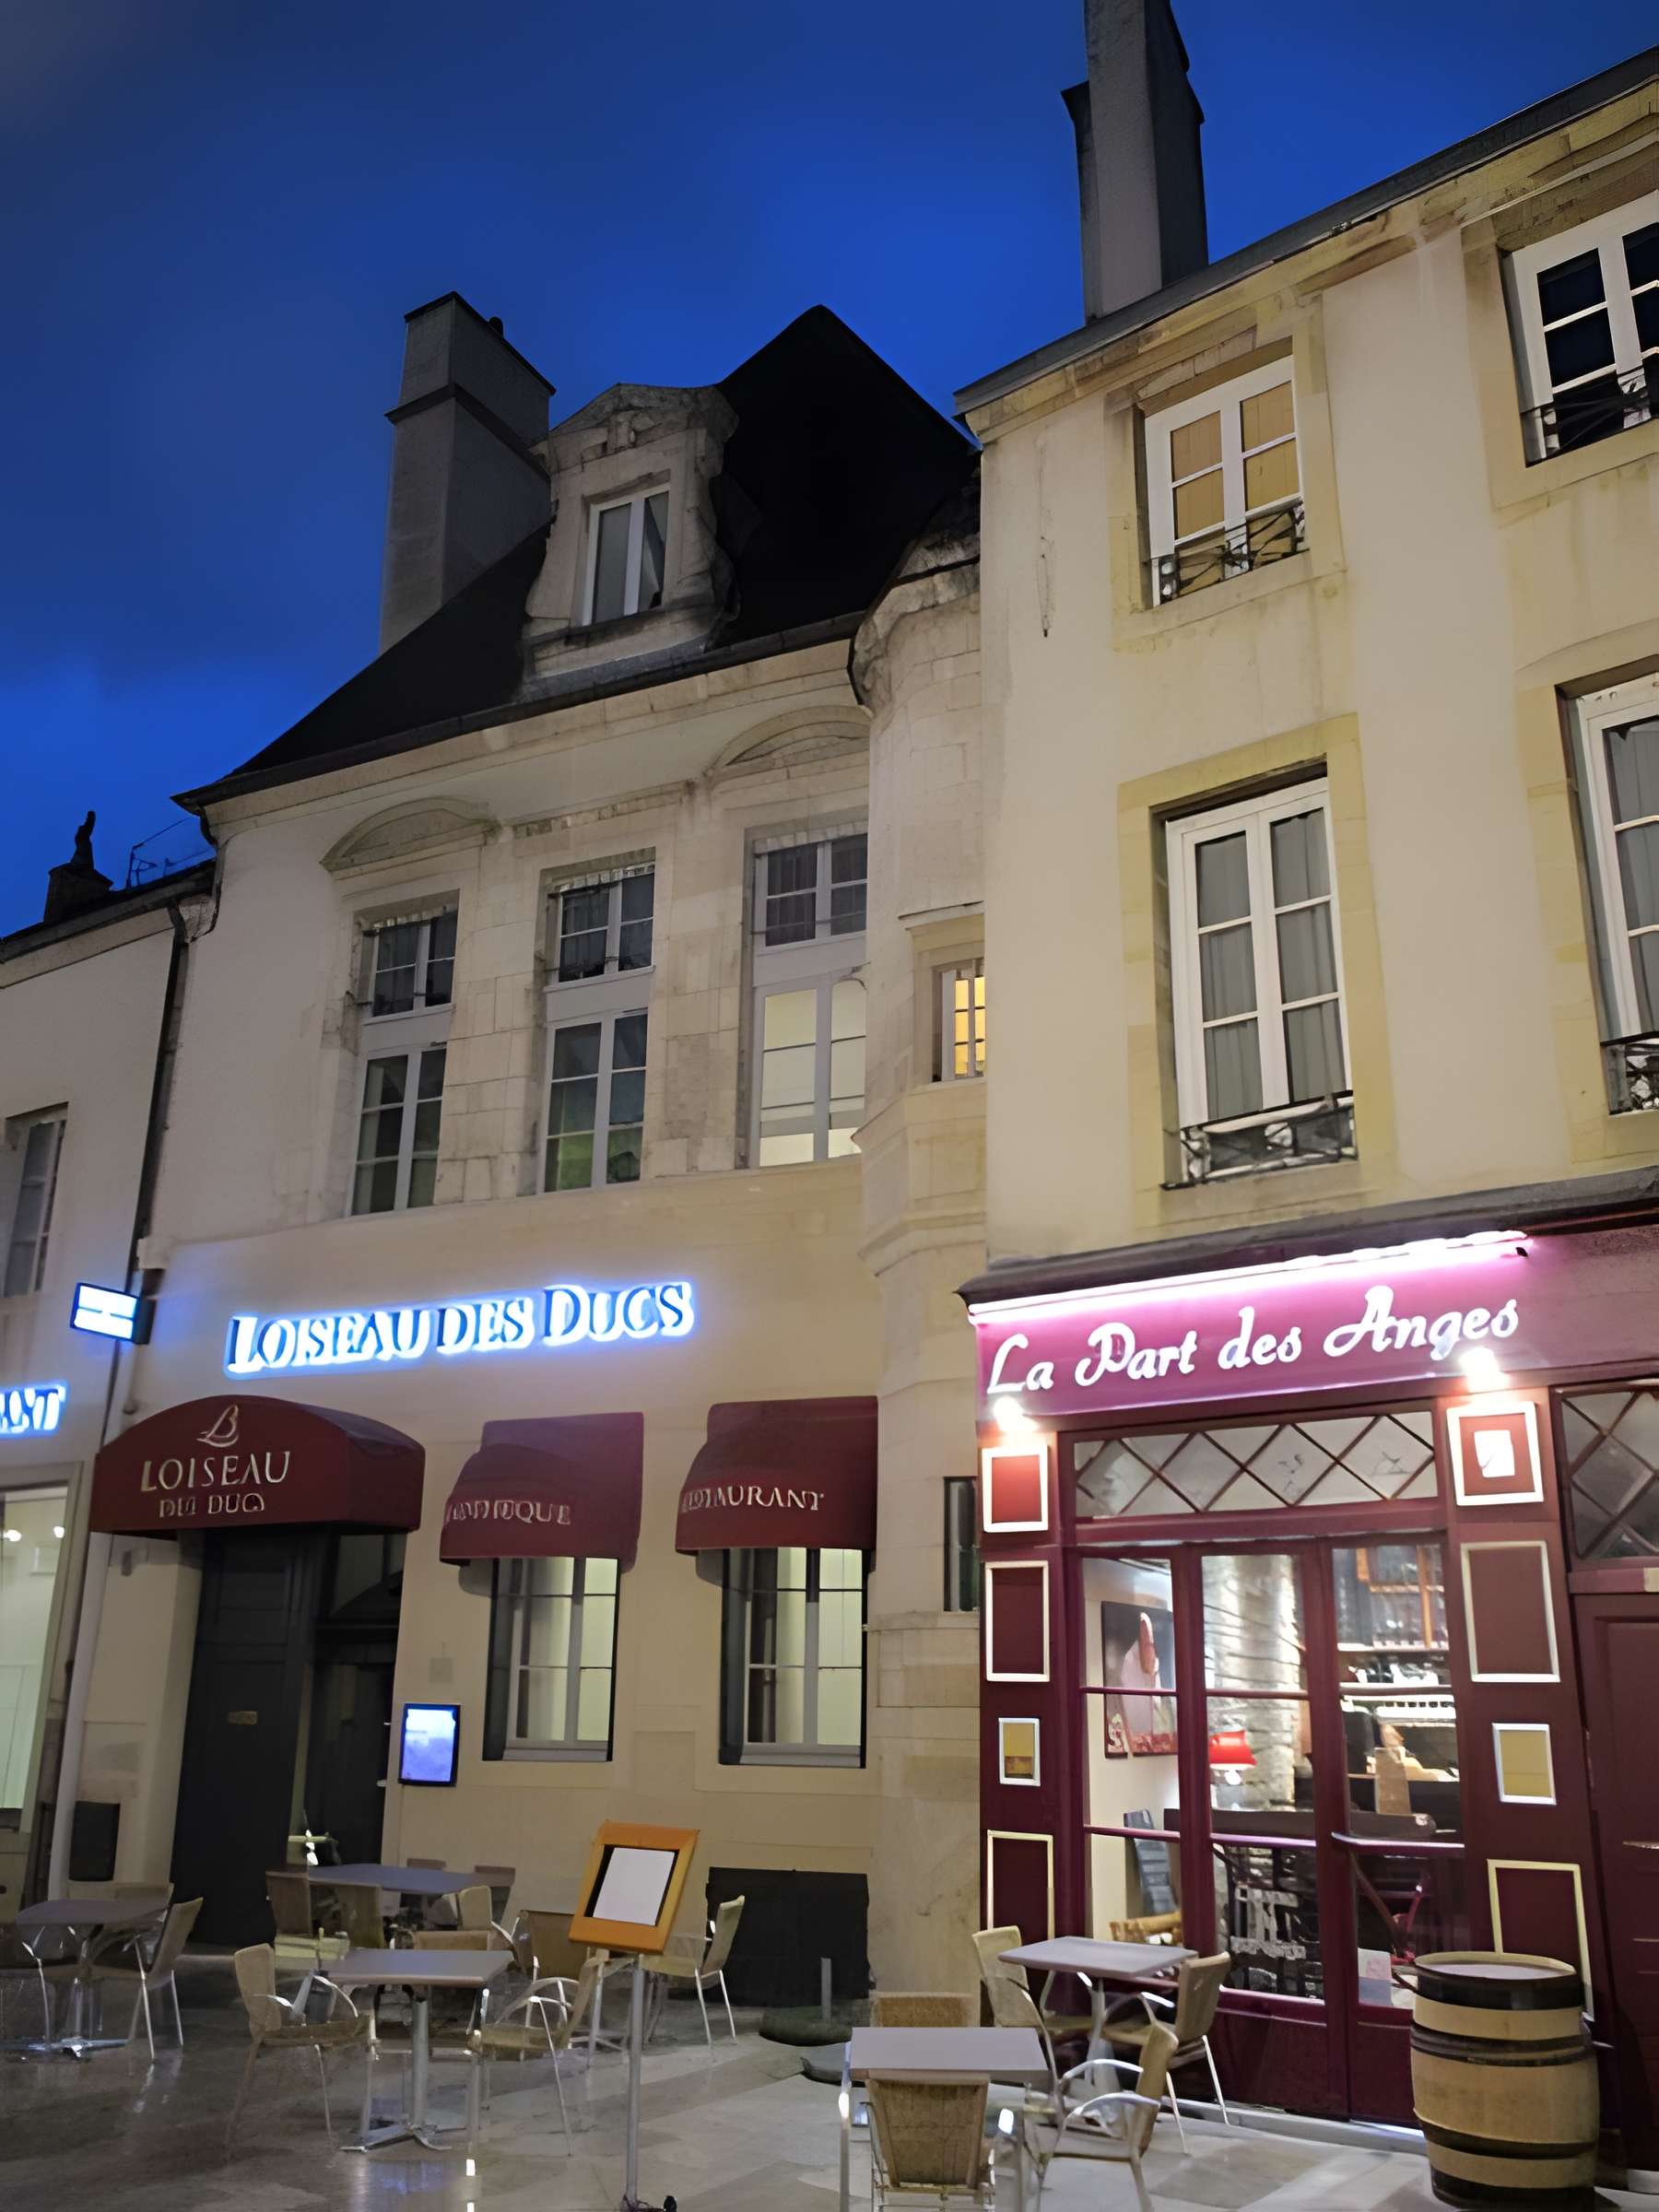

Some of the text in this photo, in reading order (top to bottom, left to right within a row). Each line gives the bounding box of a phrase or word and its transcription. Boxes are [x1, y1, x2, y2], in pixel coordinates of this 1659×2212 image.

[437, 1298, 534, 1353] DES
[542, 1282, 695, 1347] DUCS
[986, 1284, 1520, 1394] La Part des Anges
[140, 1450, 290, 1492] LOISEAU
